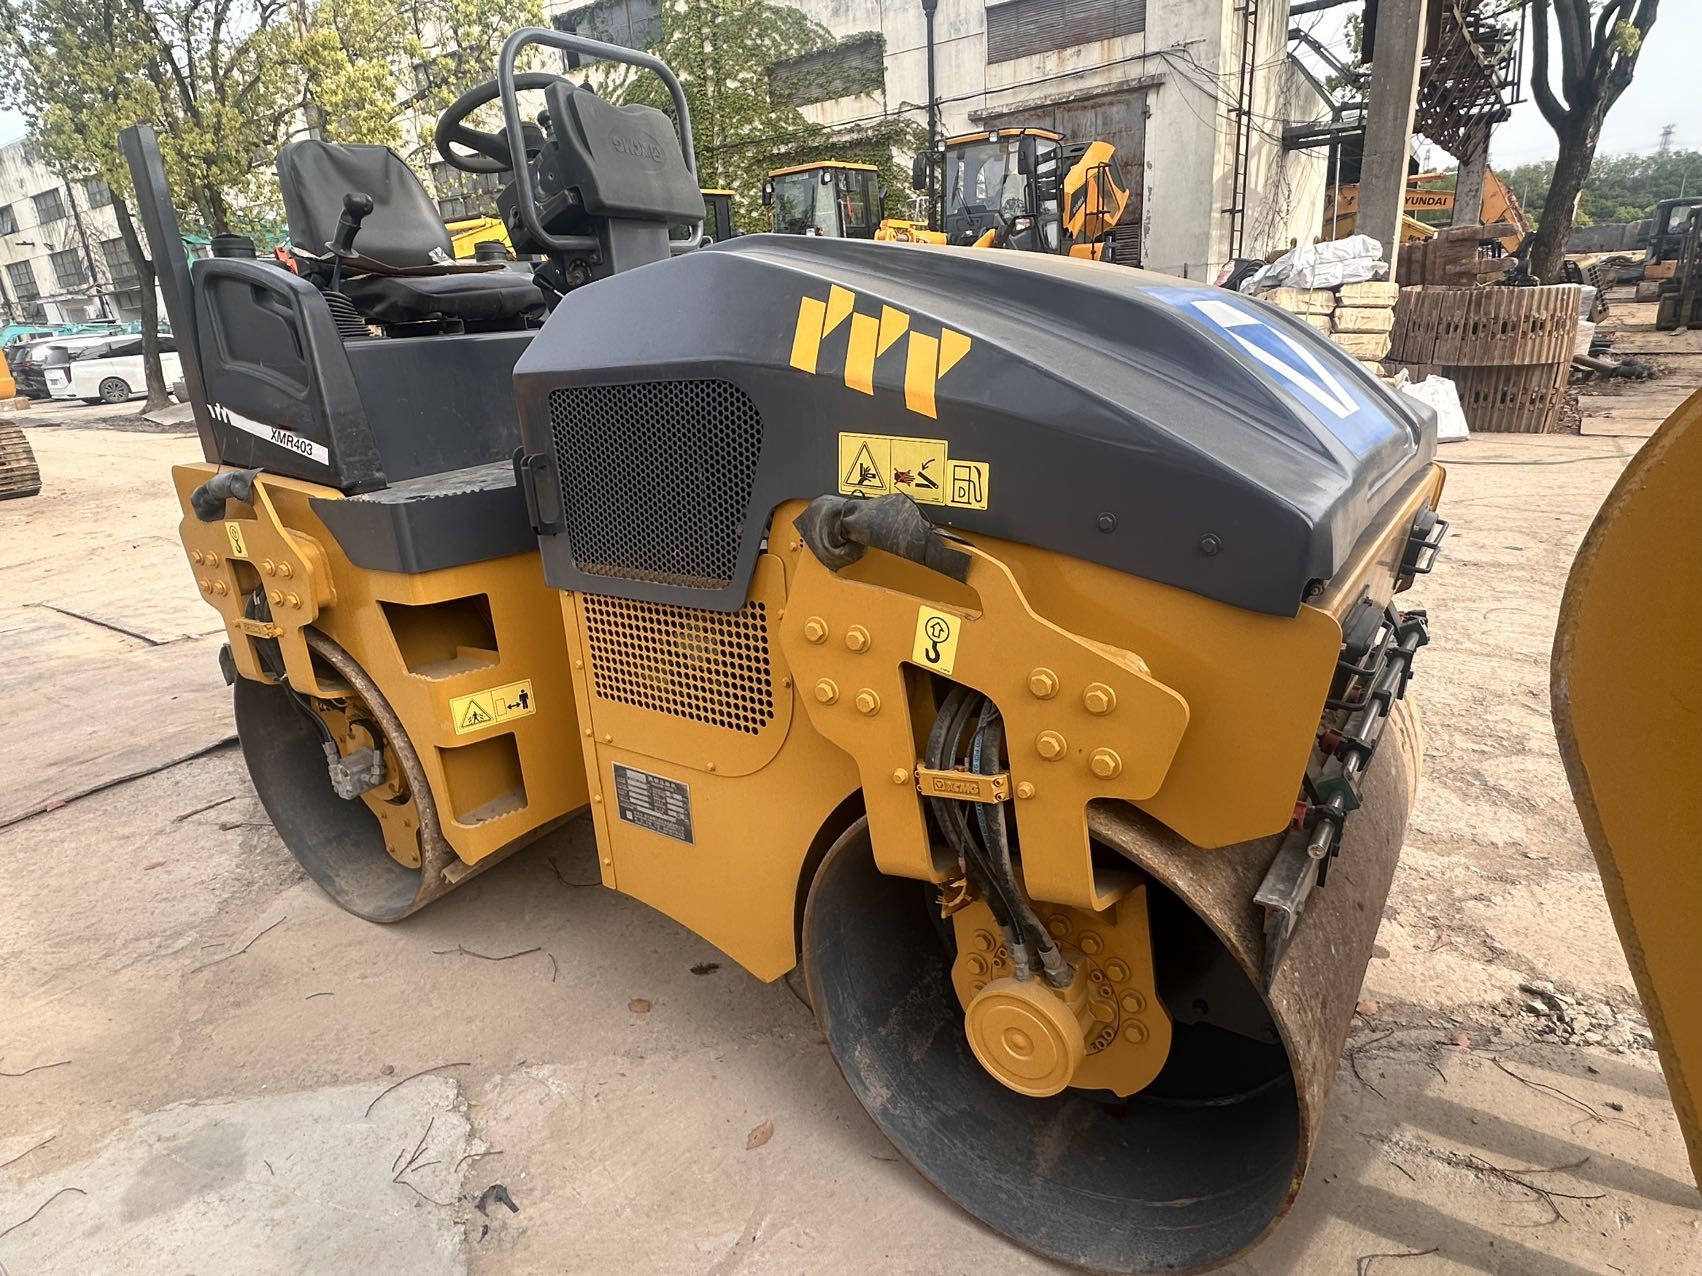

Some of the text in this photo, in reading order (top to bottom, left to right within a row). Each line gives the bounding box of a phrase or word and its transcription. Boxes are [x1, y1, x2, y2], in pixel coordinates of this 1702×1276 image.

[1405, 197, 1447, 206] YUNDAI
[271, 427, 313, 456] XMR403
[944, 780, 980, 795] XCMG
